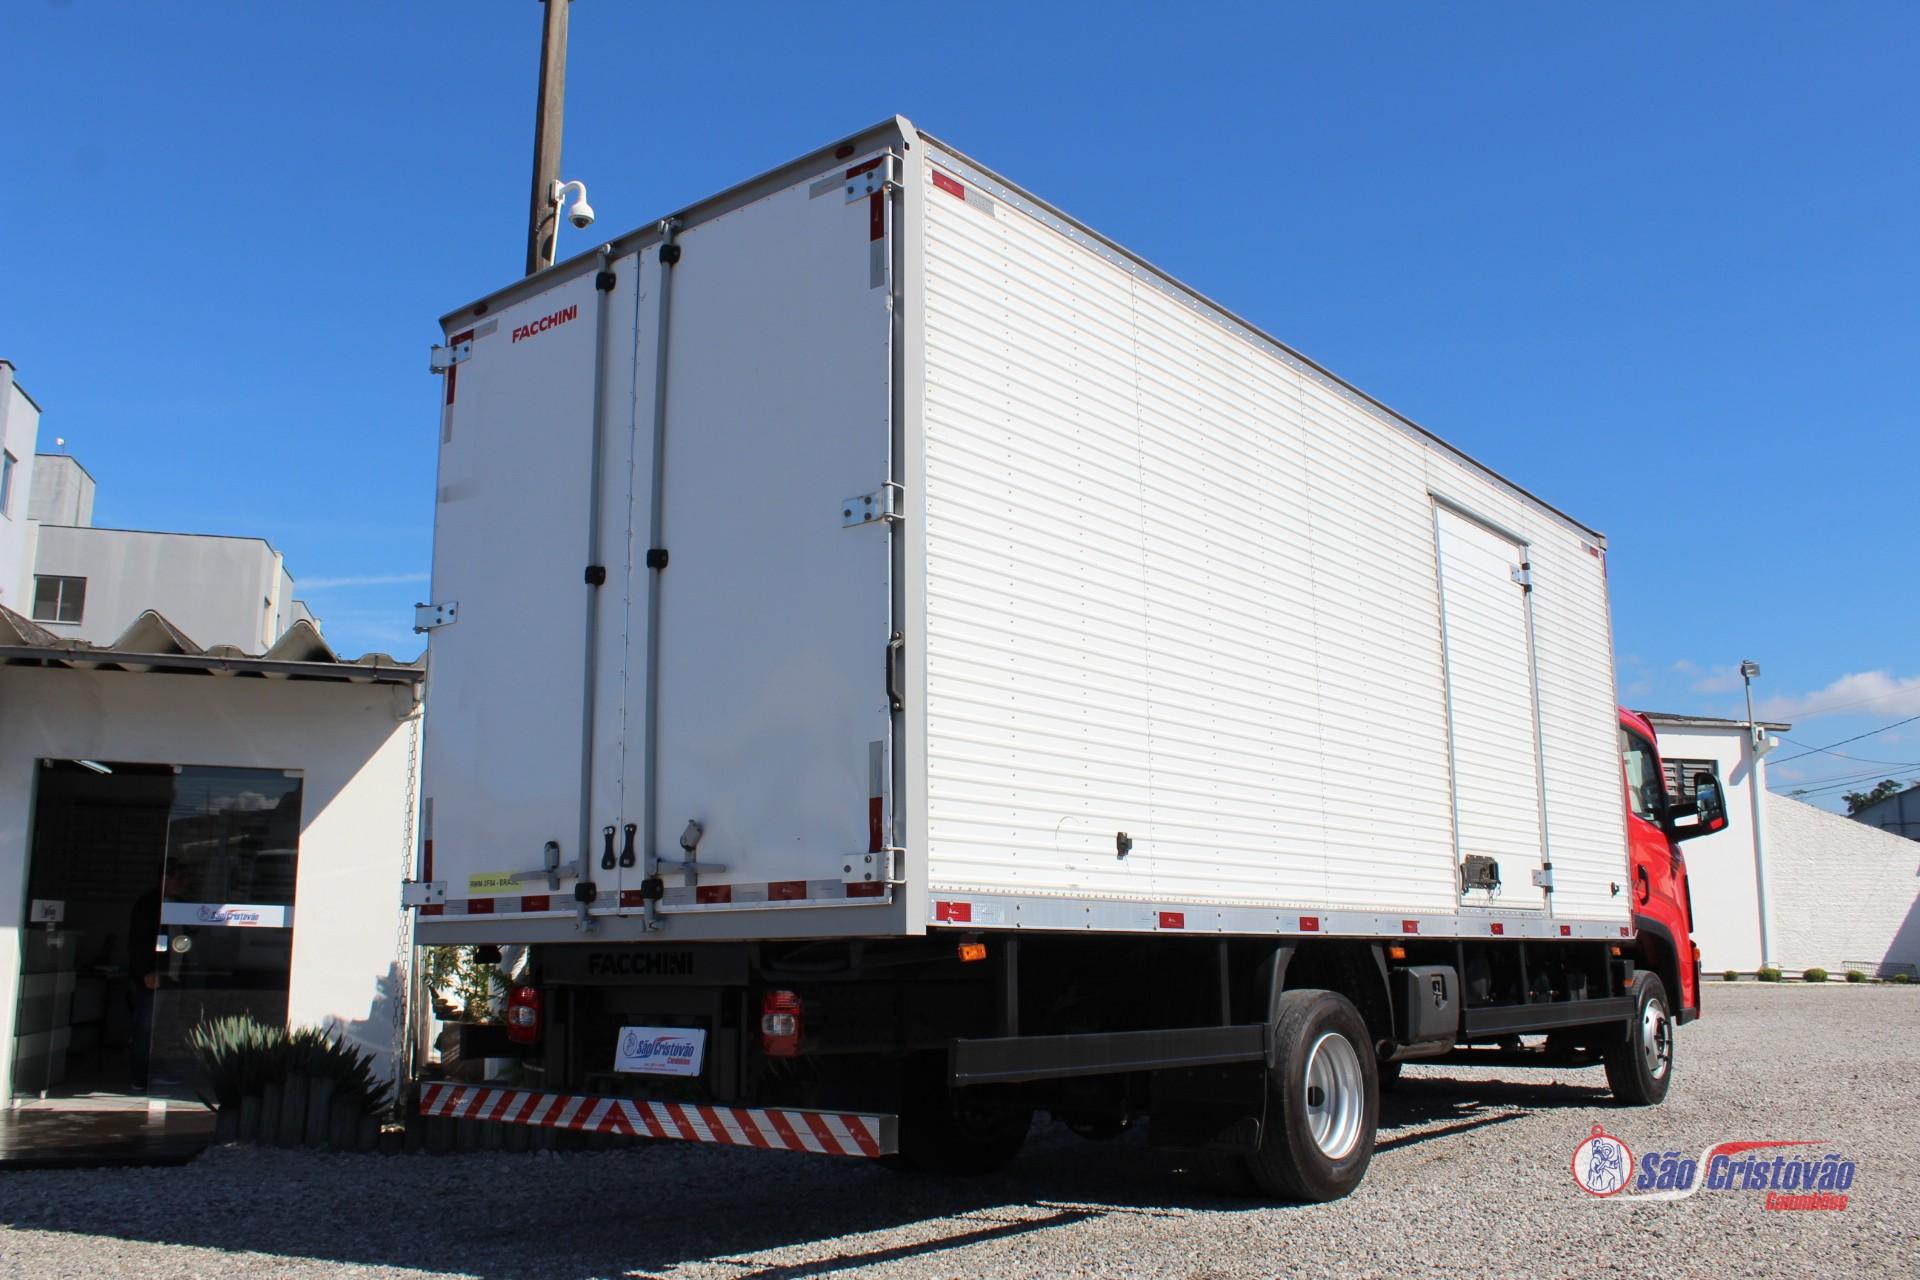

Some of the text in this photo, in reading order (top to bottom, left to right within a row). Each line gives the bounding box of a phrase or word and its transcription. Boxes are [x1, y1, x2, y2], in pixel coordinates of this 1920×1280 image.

[512, 304, 577, 343] FACCHINI
[588, 951, 694, 976] FACCHINI
[636, 1039, 695, 1058] São Cristóvão
